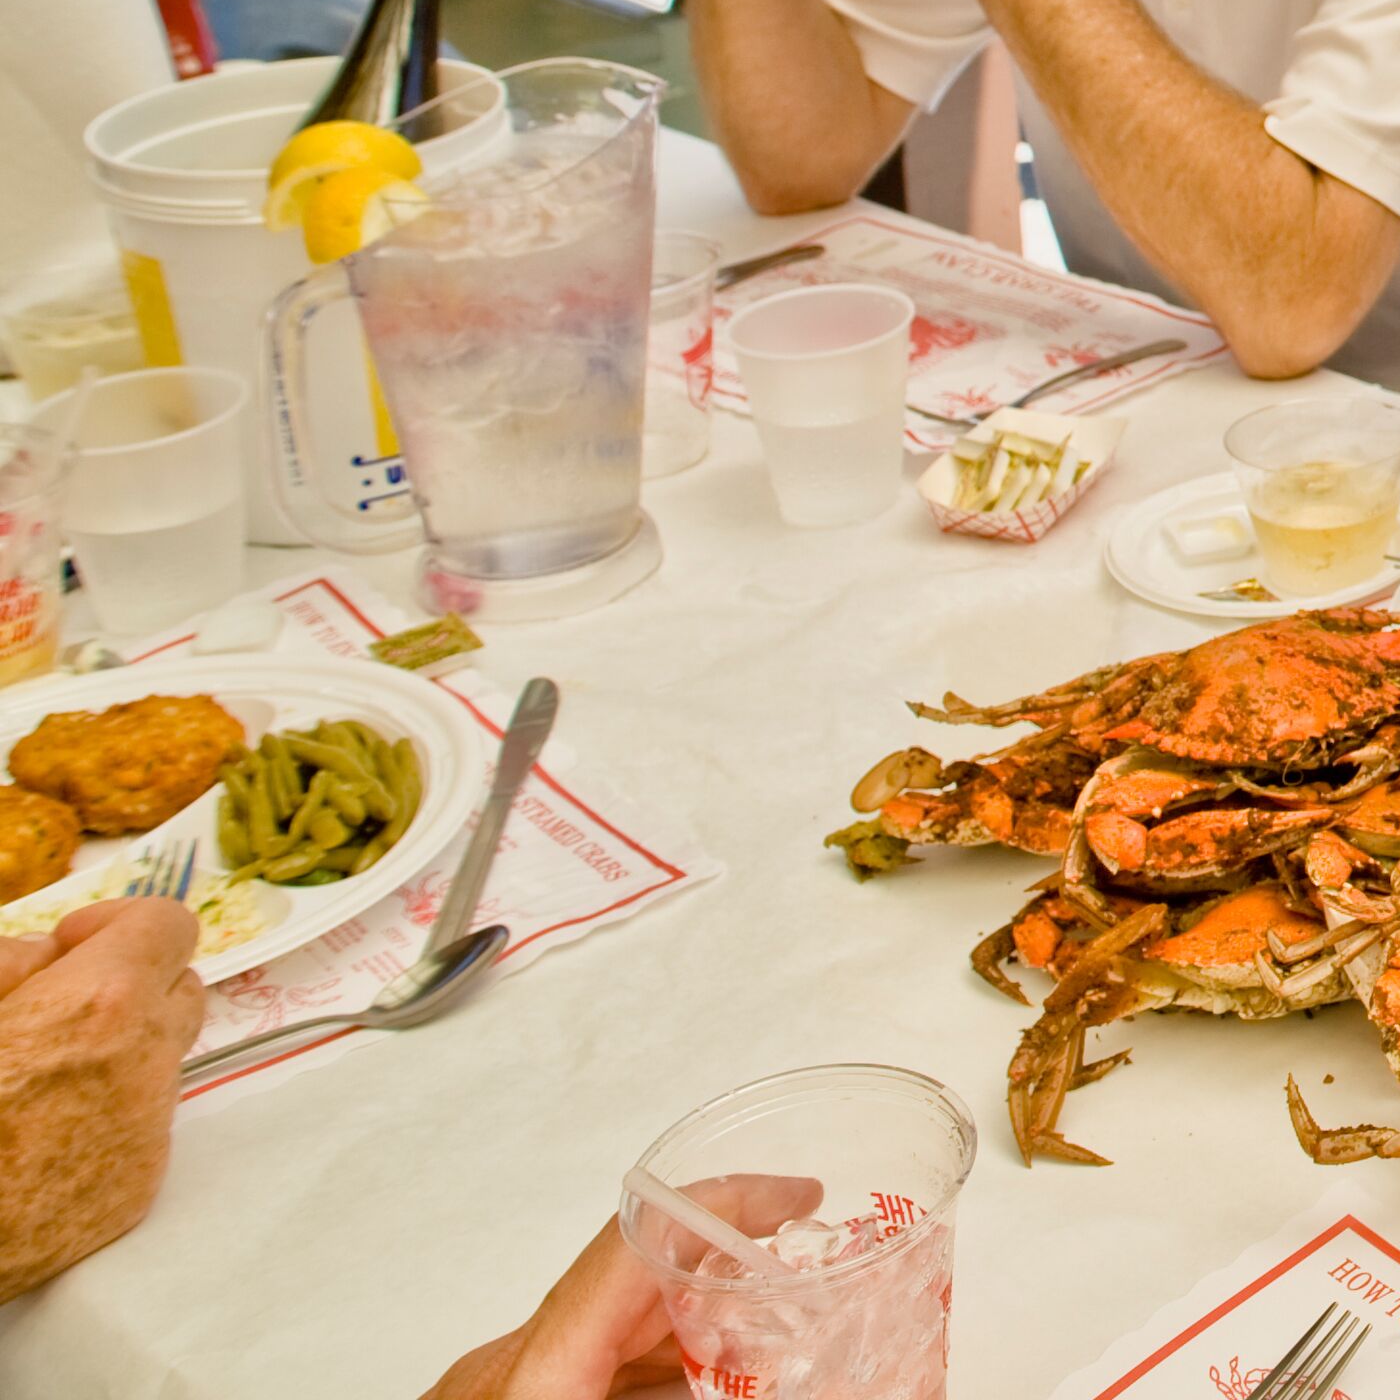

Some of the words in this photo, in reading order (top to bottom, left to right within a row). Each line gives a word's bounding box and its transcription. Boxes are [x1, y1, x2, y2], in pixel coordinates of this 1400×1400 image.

[572, 842, 631, 883] CRABS
[1327, 1257, 1396, 1305] HOW
[708, 1366, 759, 1400] THE
